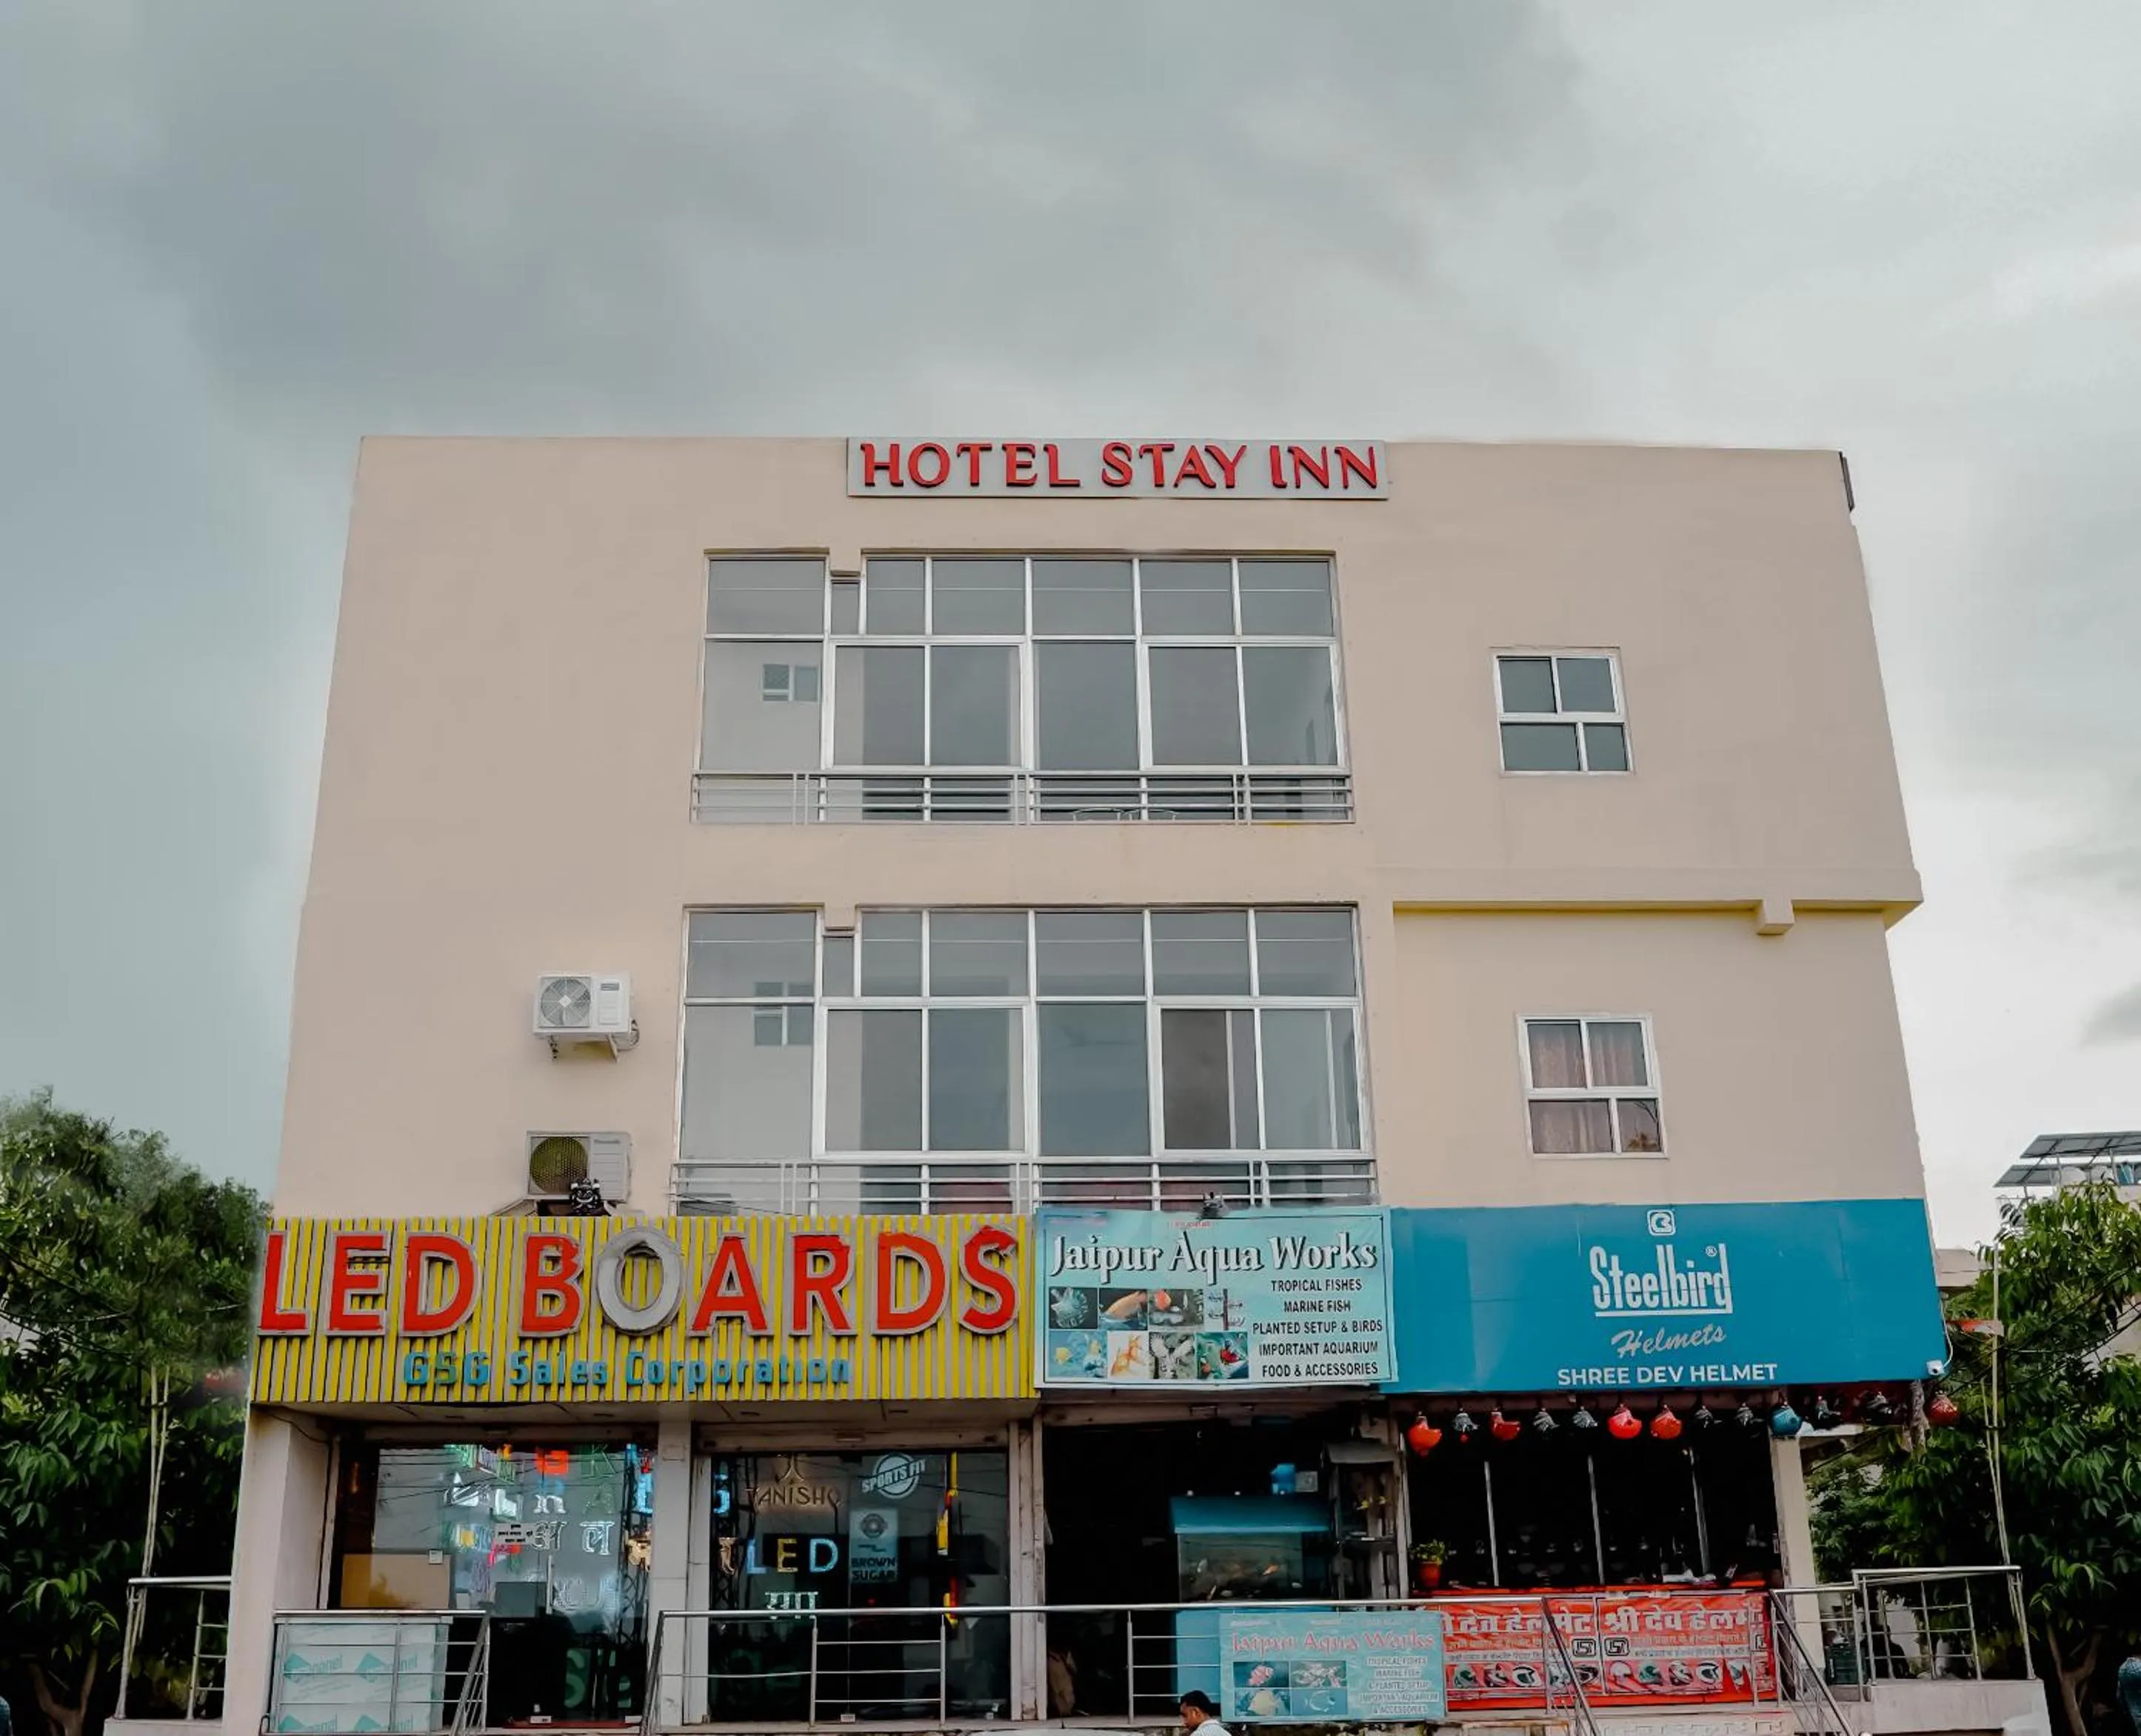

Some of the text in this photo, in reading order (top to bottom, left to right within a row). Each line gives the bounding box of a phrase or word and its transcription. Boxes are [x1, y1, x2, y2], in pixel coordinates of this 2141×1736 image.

[860, 442, 1378, 490] HOTEL STAY INN
[1050, 1231, 1378, 1285] Jaipur Aqua Works
[258, 1225, 1021, 1337] LED BOARDS
[1272, 1279, 1363, 1292] TROPICAL FISHES
[1589, 1243, 1732, 1311] Steelbird
[1284, 1300, 1351, 1312] MARINE FISH
[1252, 1320, 1383, 1334] PLANTED SETUP & BIRDS
[1259, 1341, 1378, 1356] IMPORTANT AQUARIUM
[1611, 1323, 1727, 1358] Helmets
[404, 1350, 849, 1394] GSG Sales Corporation
[1263, 1362, 1378, 1378] FOOD & ACCESSORIES
[1557, 1363, 1777, 1386] SHREE DEV HELMET
[861, 1465, 909, 1494] SPORTS
[745, 1538, 838, 1574] LED
[852, 1557, 896, 1568] BROWN
[852, 1569, 895, 1580] SUGAR
